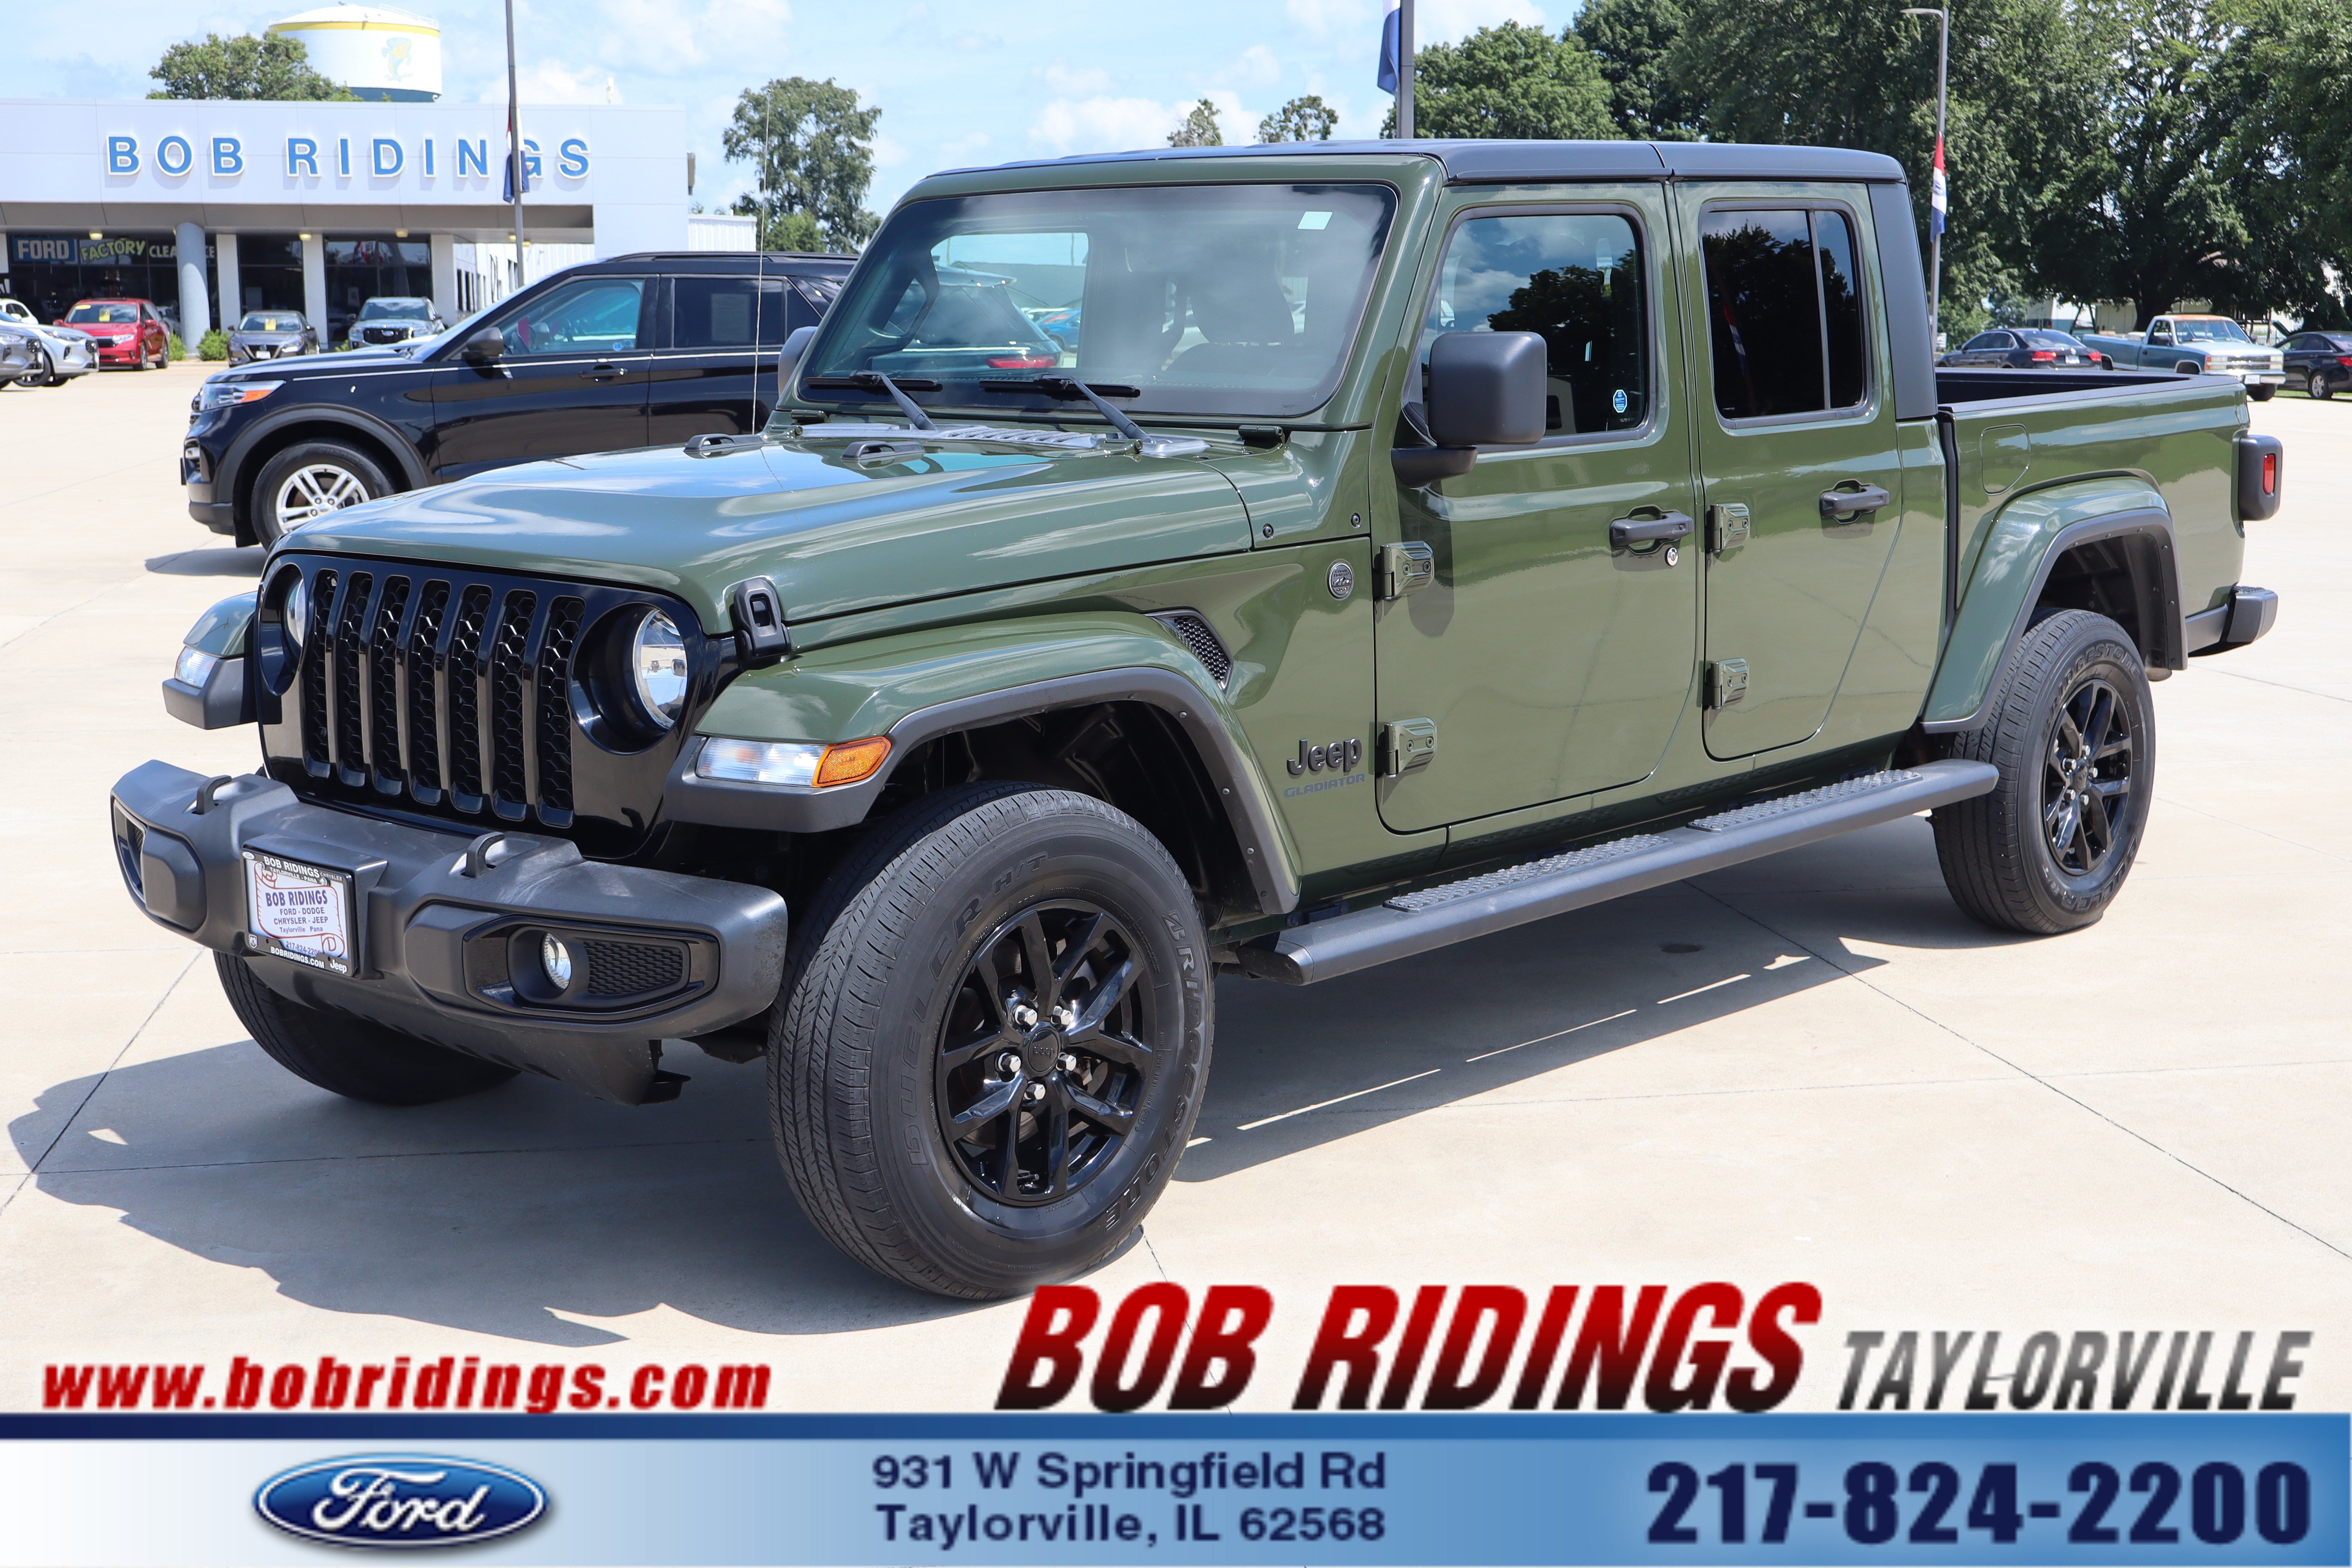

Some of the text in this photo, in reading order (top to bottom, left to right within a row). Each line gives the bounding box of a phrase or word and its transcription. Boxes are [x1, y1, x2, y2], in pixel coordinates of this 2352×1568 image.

[107, 134, 590, 179] BOB RIDINGS
[18, 239, 69, 260] FORD
[81, 240, 146, 262] FACTORY
[1287, 738, 1362, 775] Jeep
[1284, 773, 1366, 798] GLADIATOR
[263, 856, 320, 878] BOB RIDINGS
[270, 867, 300, 880] TAYLORVILLE
[320, 872, 343, 881] CHRYSLER
[265, 889, 328, 906] BOB RIDINGS
[271, 947, 325, 969] BOBRIDINGS.COM
[330, 959, 347, 974] Jeep
[900, 851, 1048, 1166] DUELER H/T
[1105, 910, 1202, 1233] BRIDGESTONE
